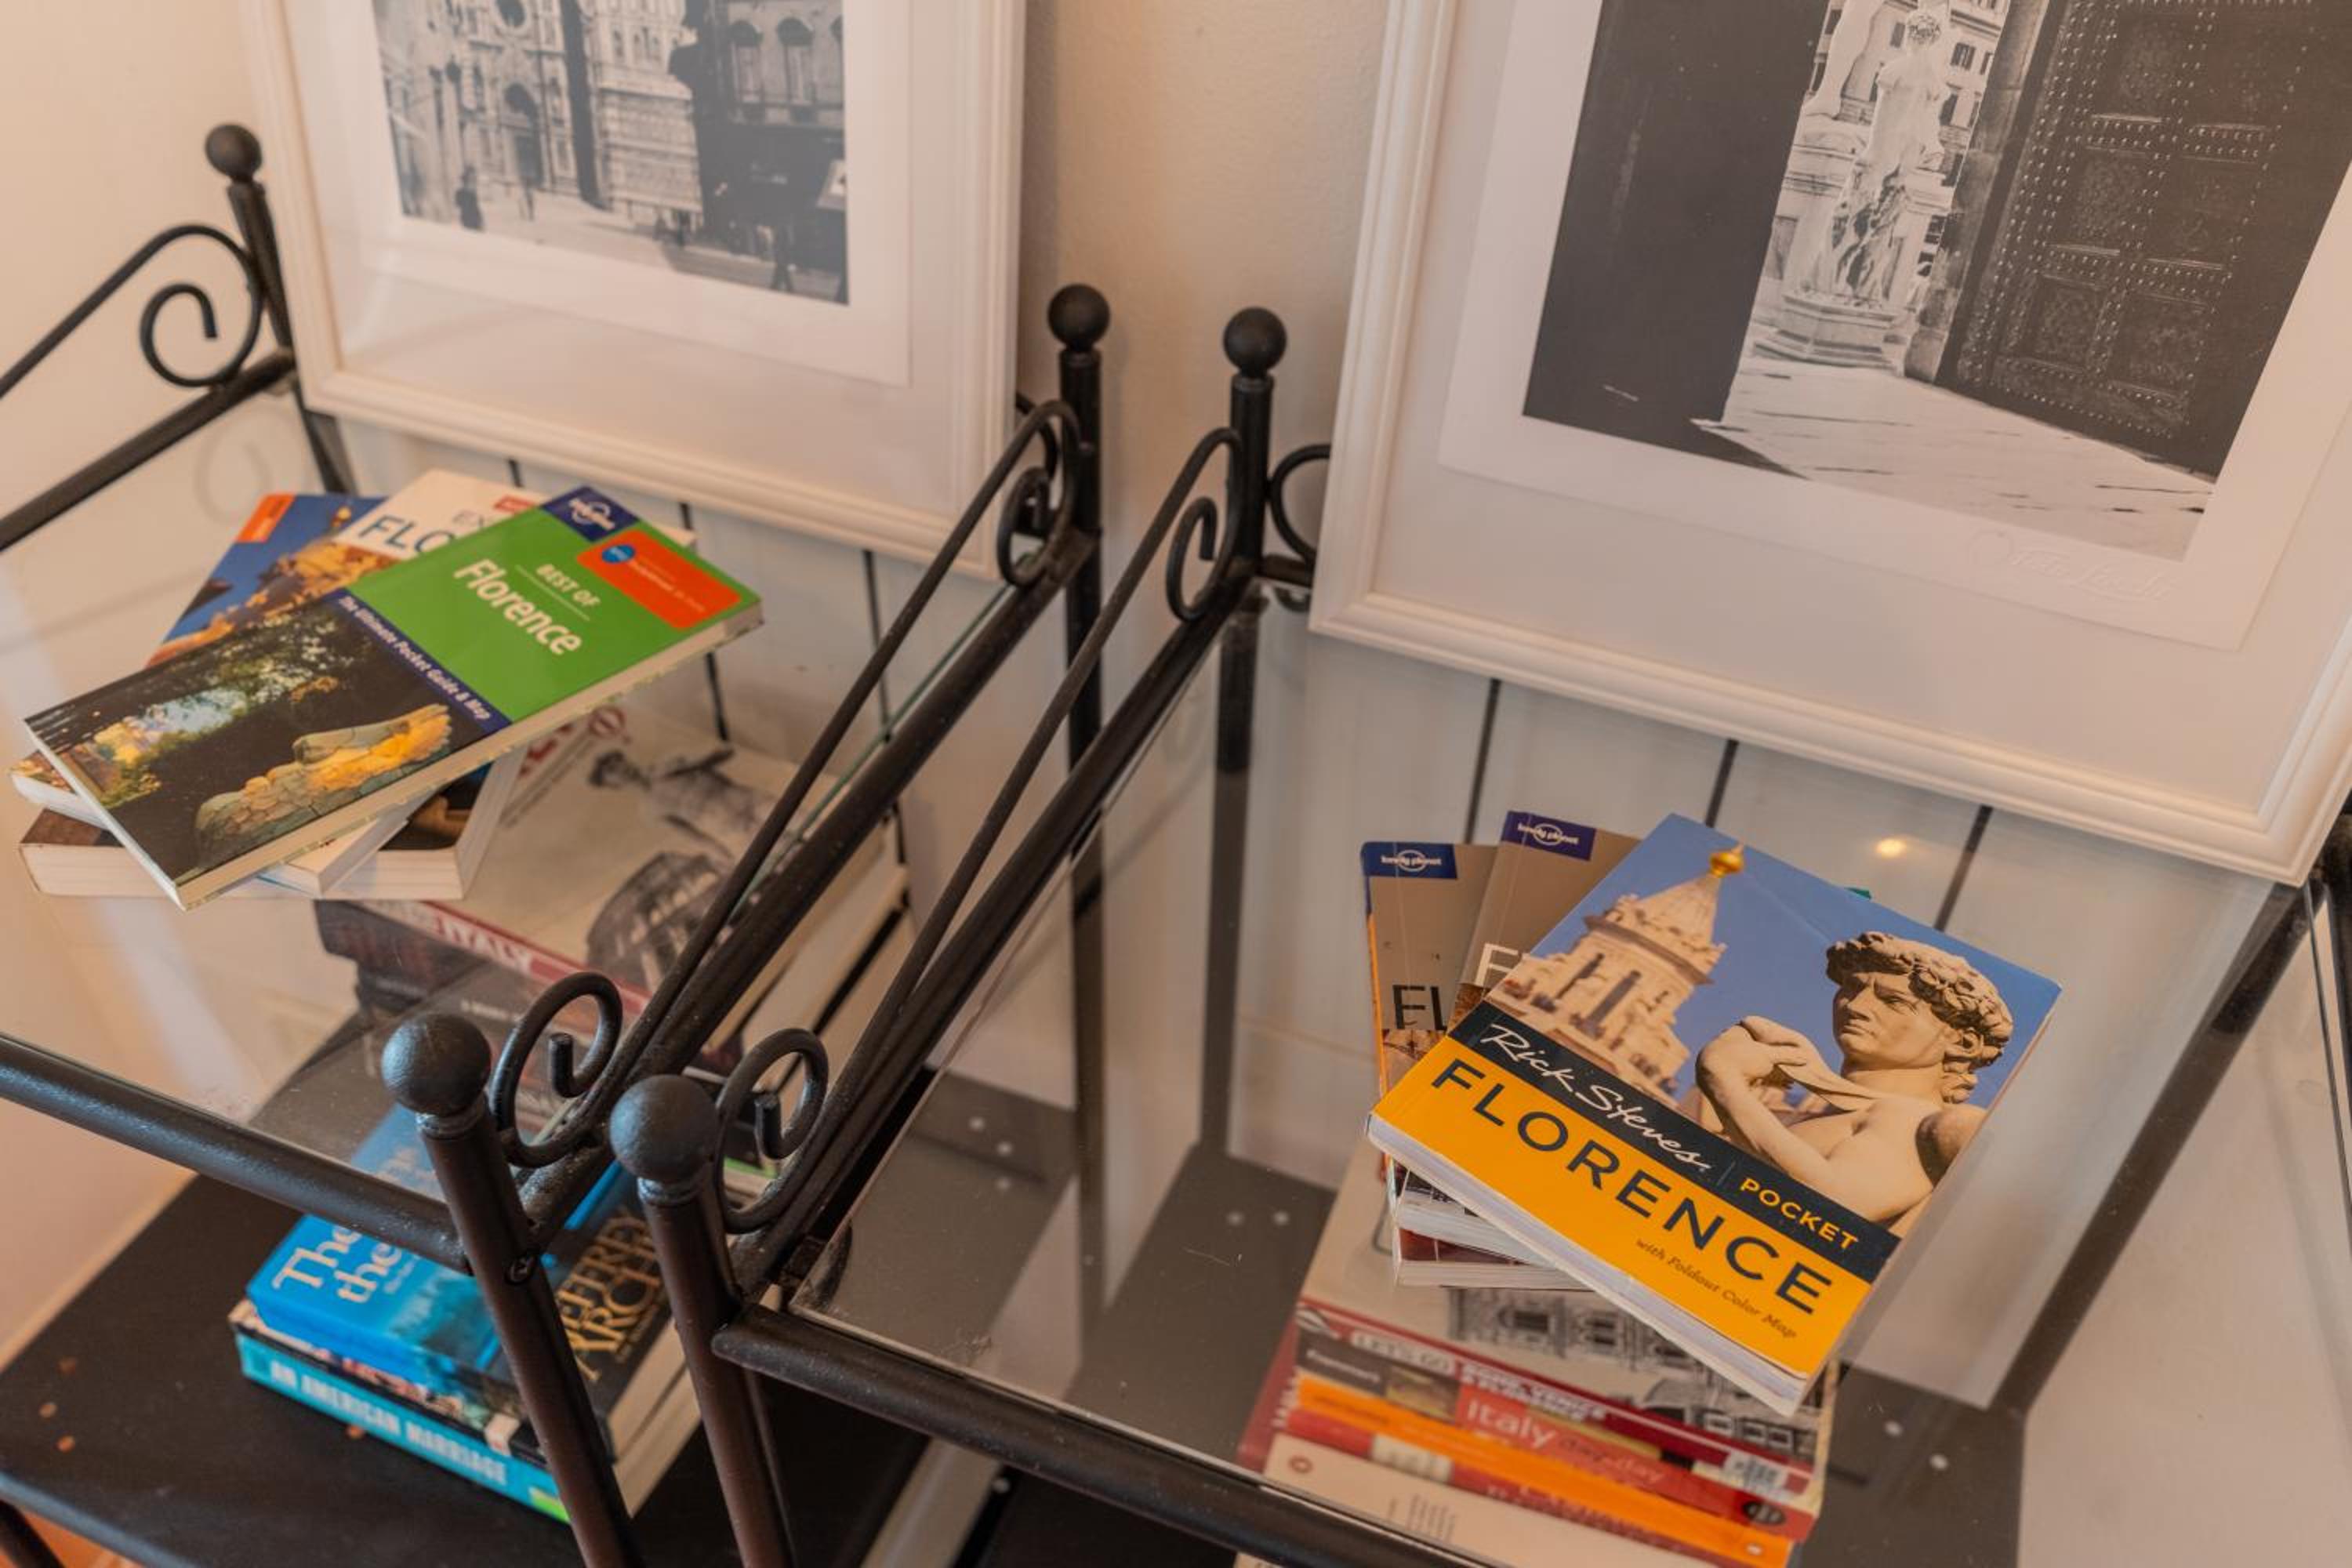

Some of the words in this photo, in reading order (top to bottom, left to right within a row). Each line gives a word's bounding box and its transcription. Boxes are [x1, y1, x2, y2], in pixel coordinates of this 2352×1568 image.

[454, 558, 582, 655] Florence
[536, 564, 579, 592] BEST
[573, 590, 601, 607] OF
[1480, 1023, 1575, 1093] Rick
[1429, 1058, 1833, 1315] FLORENCE
[1740, 1178, 1859, 1251] POCKET
[1635, 1239, 1665, 1260] with
[1668, 1256, 1720, 1292] Foldout
[1722, 1290, 1761, 1315] Color
[1762, 1314, 1797, 1338] Map
[1467, 1399, 1558, 1449] Italy
